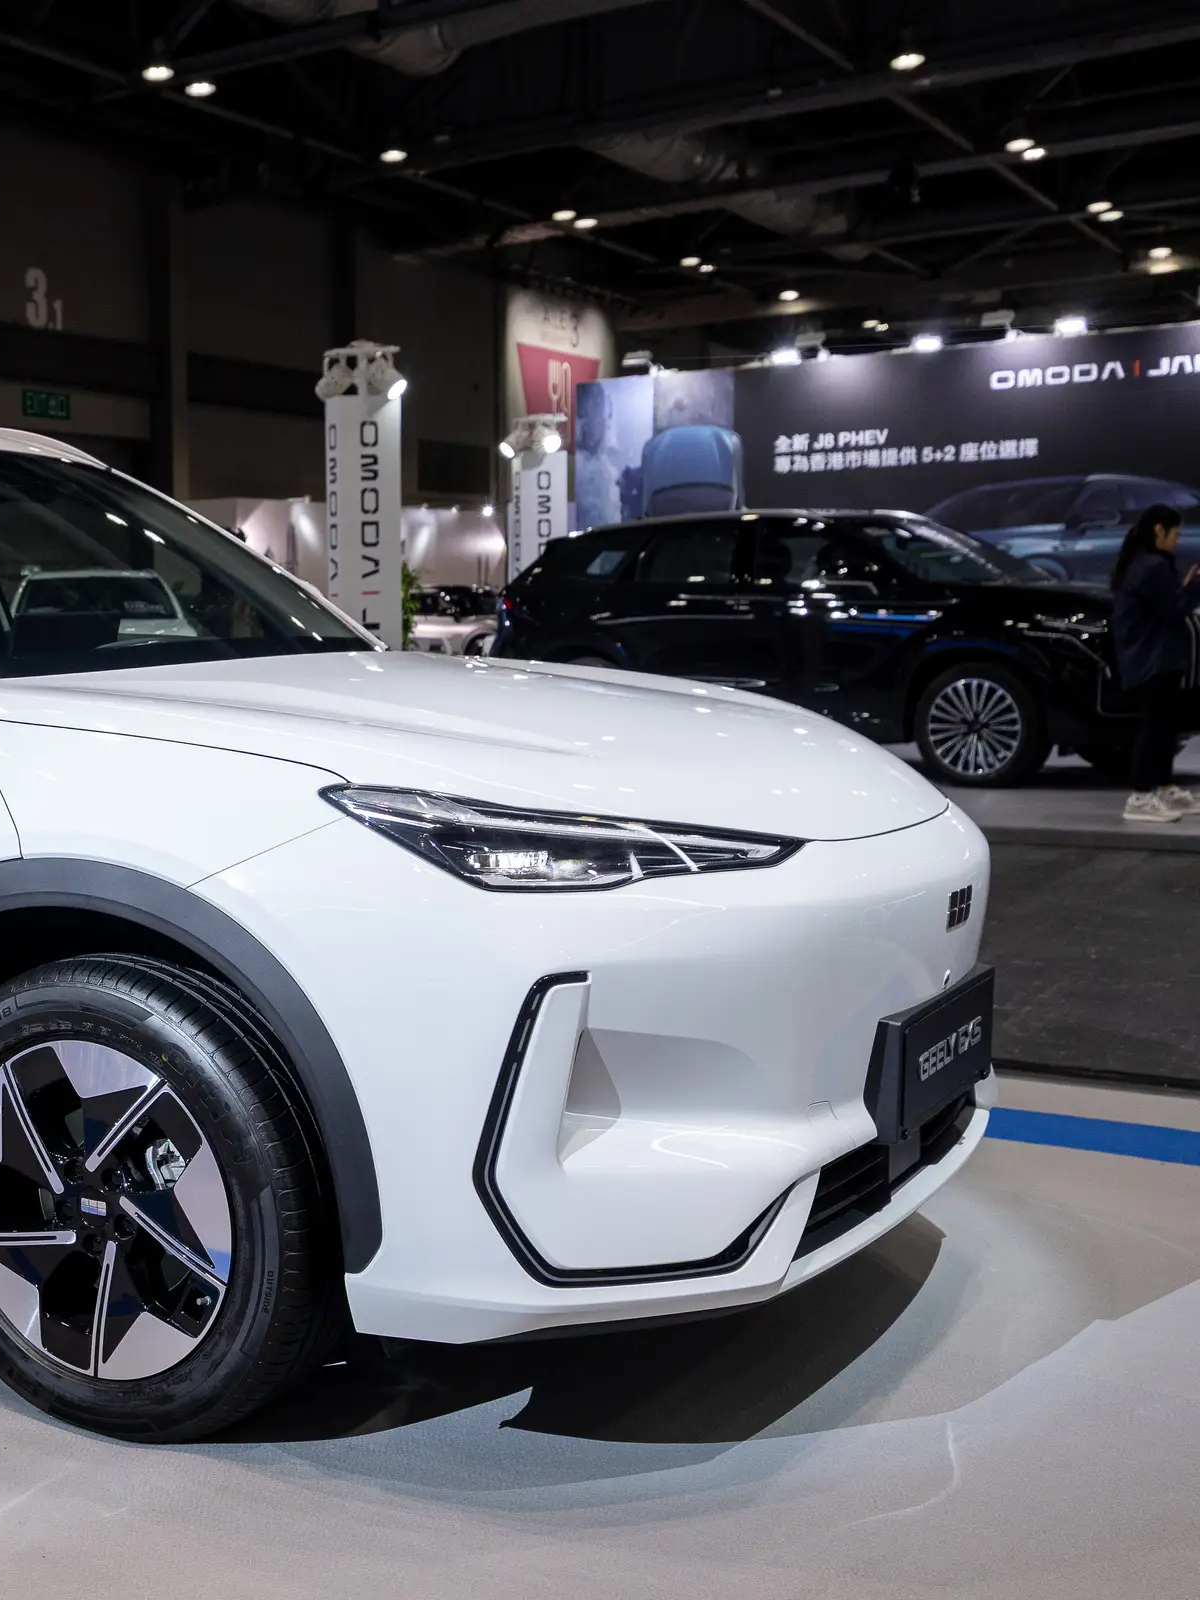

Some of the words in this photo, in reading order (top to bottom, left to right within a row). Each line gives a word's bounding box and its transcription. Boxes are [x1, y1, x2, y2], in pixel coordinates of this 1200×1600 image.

[25, 267, 63, 331] 3.1
[990, 361, 1125, 390] OMODA
[773, 446, 917, 474] 專為香港市場提供
[921, 444, 956, 463] 5+2
[958, 438, 1039, 463] 座位選擇
[774, 433, 810, 454] 全新
[813, 432, 836, 450] J8
[838, 428, 889, 448] PHEV
[360, 420, 380, 579] OMODA
[919, 1032, 957, 1082] GEELY
[260, 1270, 275, 1315] OUTSIDE
